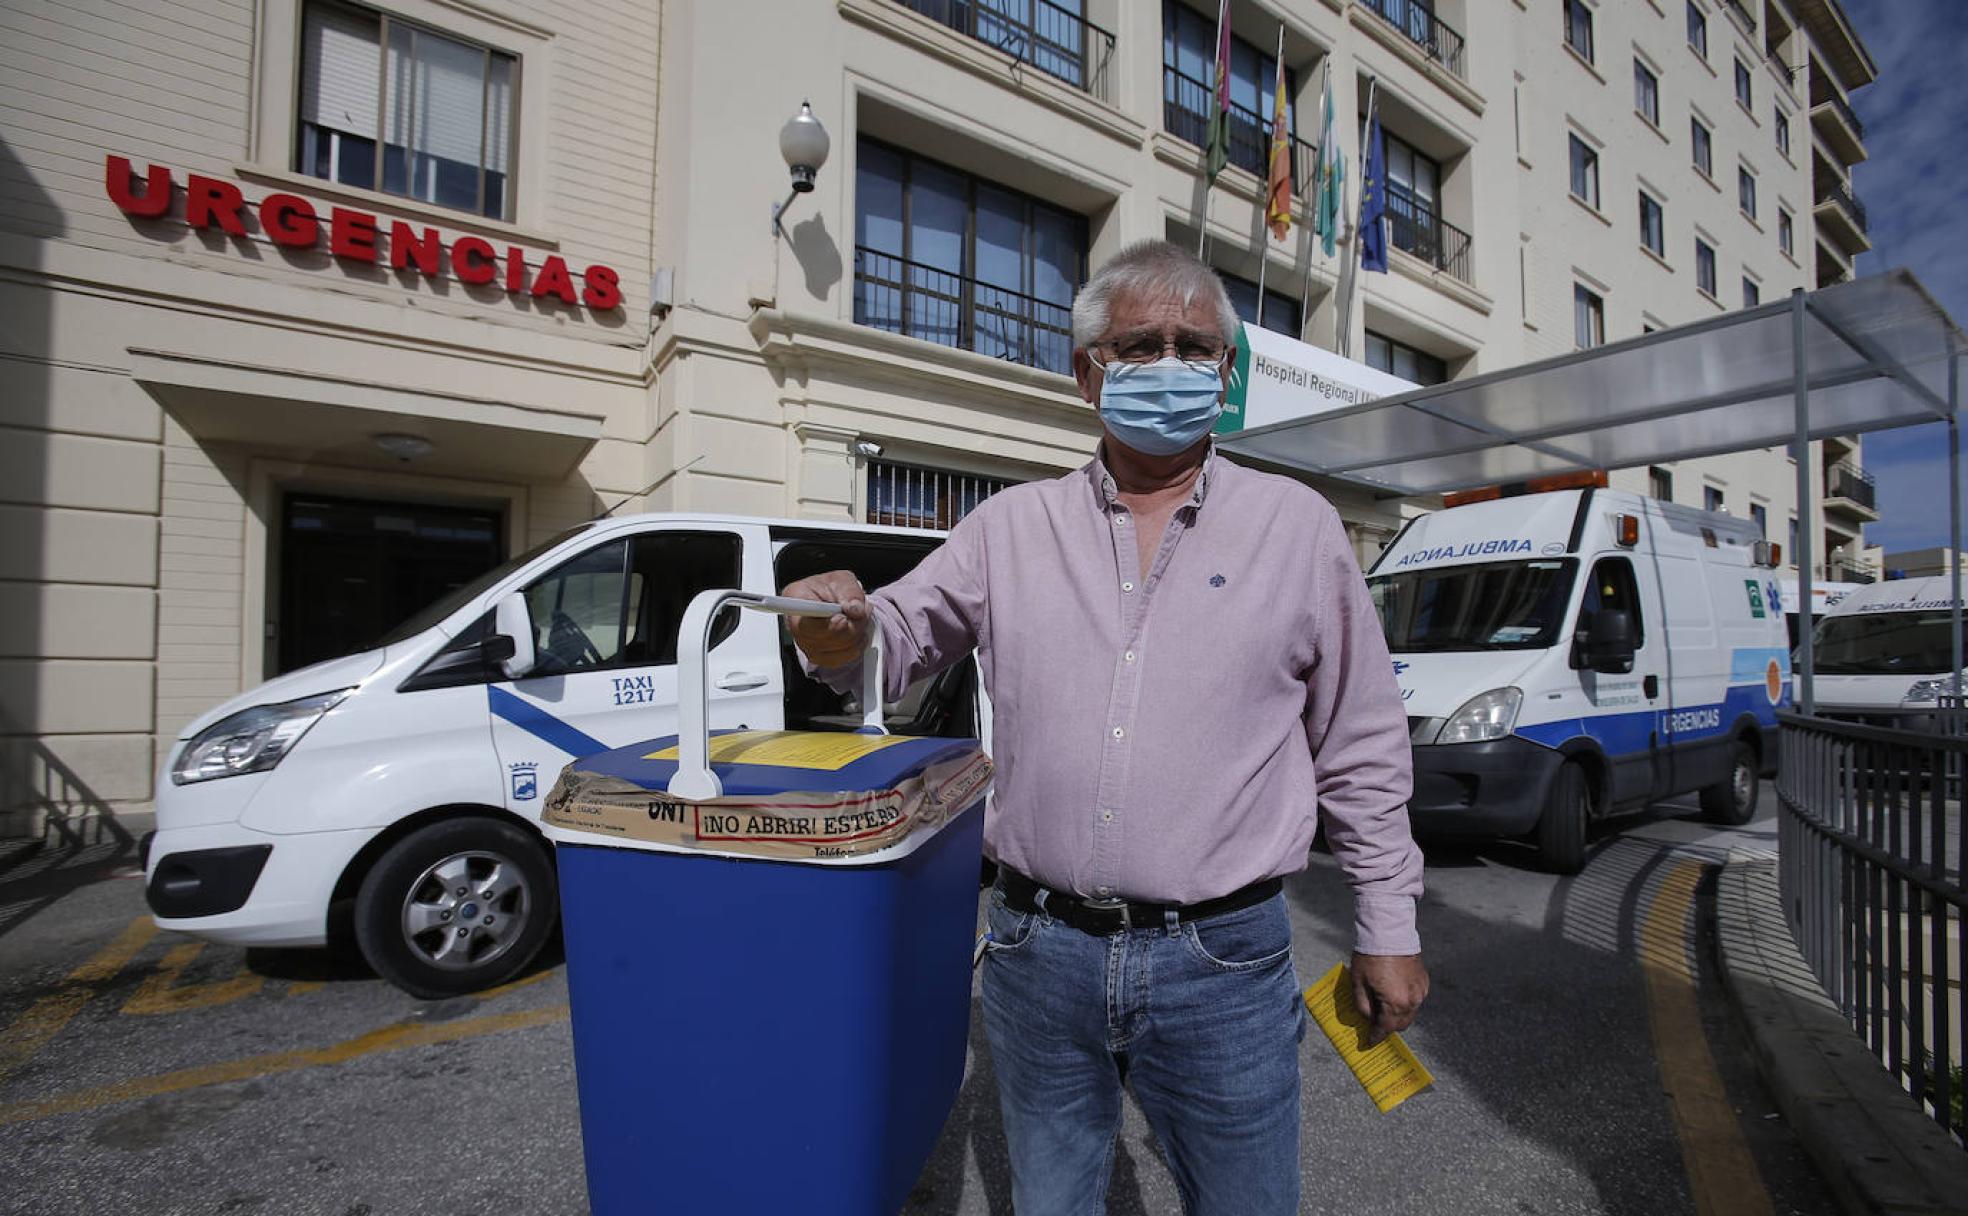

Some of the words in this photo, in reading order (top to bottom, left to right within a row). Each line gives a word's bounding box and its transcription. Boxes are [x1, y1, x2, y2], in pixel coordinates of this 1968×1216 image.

[104, 154, 622, 311] URGENCIAS
[1255, 356, 1307, 387] Hospital
[1310, 375, 1359, 405] Regional
[611, 675, 653, 690] TAXI
[614, 688, 656, 705] 1217
[1662, 708, 1720, 735] URGENCIAS
[746, 815, 816, 834] ABRIR!
